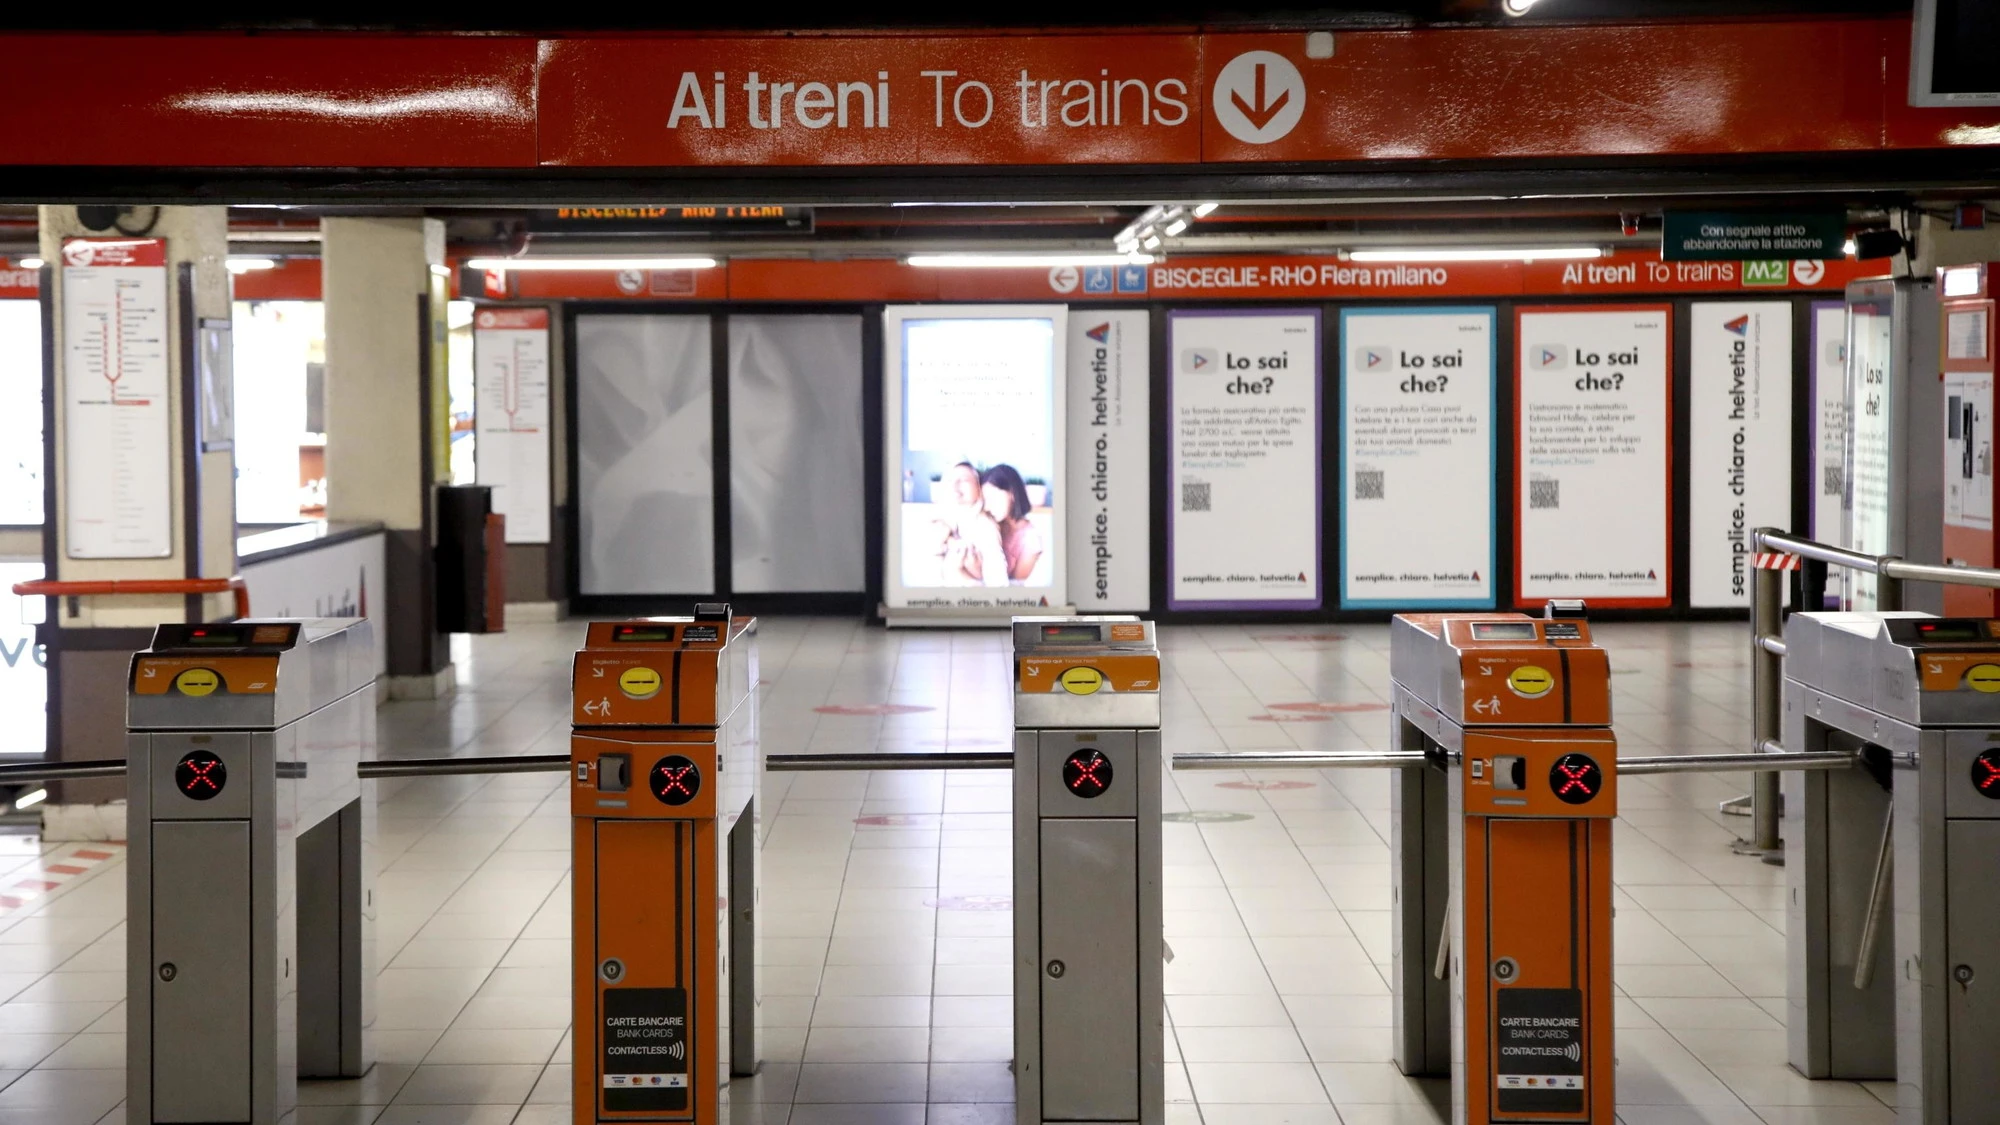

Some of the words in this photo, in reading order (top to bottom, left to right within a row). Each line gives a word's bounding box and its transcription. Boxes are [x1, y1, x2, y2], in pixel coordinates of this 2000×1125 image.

[666, 72, 725, 130] Ai
[743, 71, 890, 130] treni
[921, 70, 993, 129] To
[1016, 70, 1189, 128] trains
[1700, 225, 1724, 237] Con
[1726, 224, 1772, 239] segnale
[1773, 224, 1806, 237] attivo
[1683, 238, 1760, 250] abbandonare
[1761, 238, 1772, 250] la
[1773, 238, 1823, 250] stazione
[1320, 265, 1372, 286] Fiera
[1375, 264, 1448, 287] milano
[1562, 263, 1583, 285] Ai
[1587, 262, 1637, 284] treni
[1646, 262, 1670, 284] To
[1677, 260, 1734, 282] trains
[1747, 262, 1784, 280] M2
[1227, 351, 1251, 370] Lo
[1257, 350, 1289, 370] sai
[1400, 350, 1425, 369] Lo
[1431, 348, 1463, 368] sai
[1575, 348, 1600, 366] Lo
[1607, 346, 1639, 366] sai
[1575, 371, 1625, 391] che?
[1727, 340, 1746, 421] helvetia
[1866, 363, 1875, 384] Lo
[1875, 361, 1884, 384] sai
[1091, 347, 1108, 426] helvetia
[1226, 375, 1275, 396] che?
[1400, 373, 1449, 393] che?
[1866, 396, 1881, 417] che?
[1199, 428, 1220, 436] 2700
[1091, 432, 1108, 501] chiaro.
[1727, 426, 1746, 497] chiaro.
[1091, 507, 1113, 600] semplice.
[1727, 502, 1750, 596] semplice.
[1260, 573, 1296, 582] helvetia
[1434, 573, 1470, 582] helvetia
[1609, 571, 1646, 580] helvetia
[907, 597, 955, 609] semplice.
[957, 597, 993, 607] chiaro.
[996, 596, 1036, 607] helvetia
[606, 1017, 637, 1027] CARTE
[638, 1016, 684, 1027] BANCARIE
[1500, 1017, 1532, 1027] CARTE
[1533, 1017, 1580, 1027] BANCARIE
[616, 1028, 641, 1038] BANK
[642, 1028, 674, 1038] CARDS
[1511, 1029, 1536, 1039] BANK
[1537, 1029, 1569, 1039] CARDS
[607, 1046, 668, 1055] CONTACTLESS
[1502, 1046, 1564, 1056] CONTACTLESS
